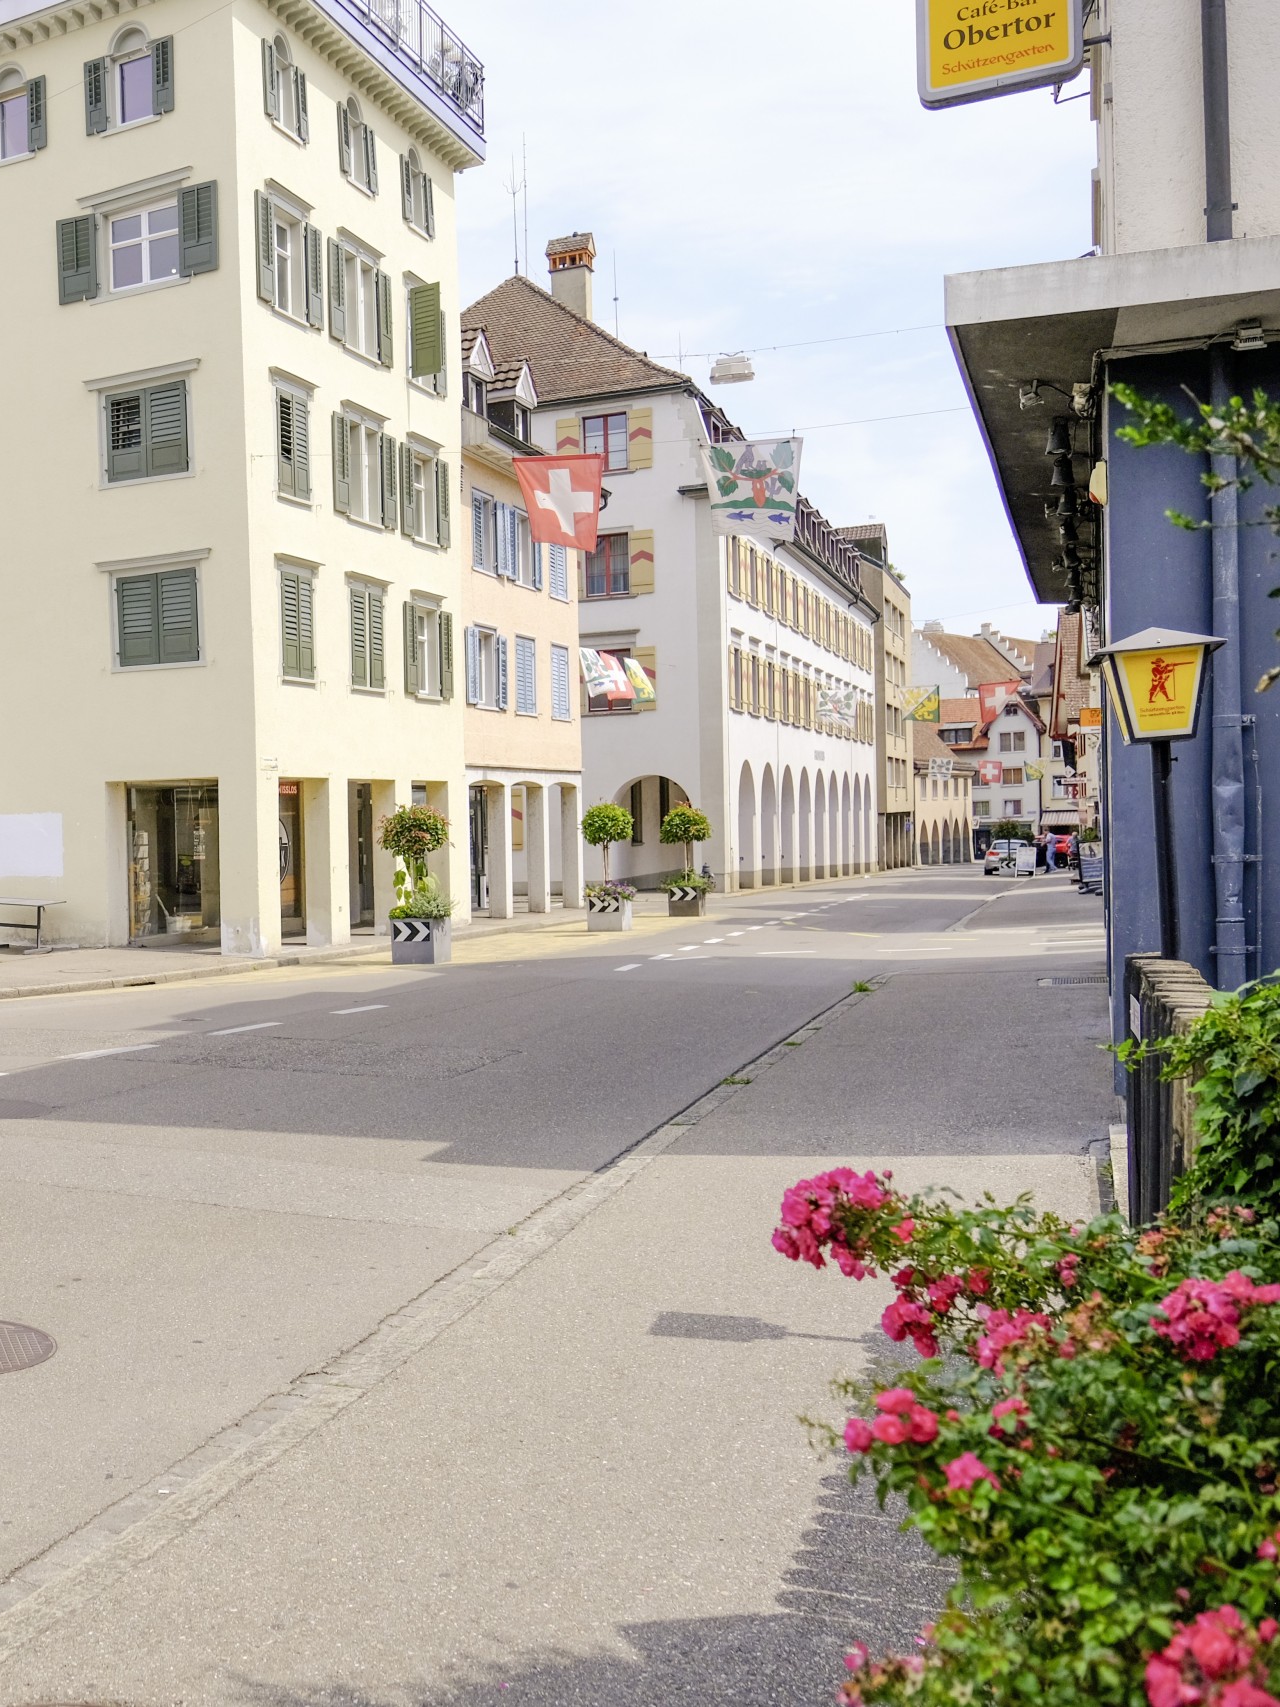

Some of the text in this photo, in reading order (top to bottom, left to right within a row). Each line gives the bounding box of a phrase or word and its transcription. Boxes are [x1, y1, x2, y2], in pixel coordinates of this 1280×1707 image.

[957, 0, 1038, 22] Café-Bar
[943, 12, 1056, 50] Obertor
[942, 44, 1055, 75] Schützengarten
